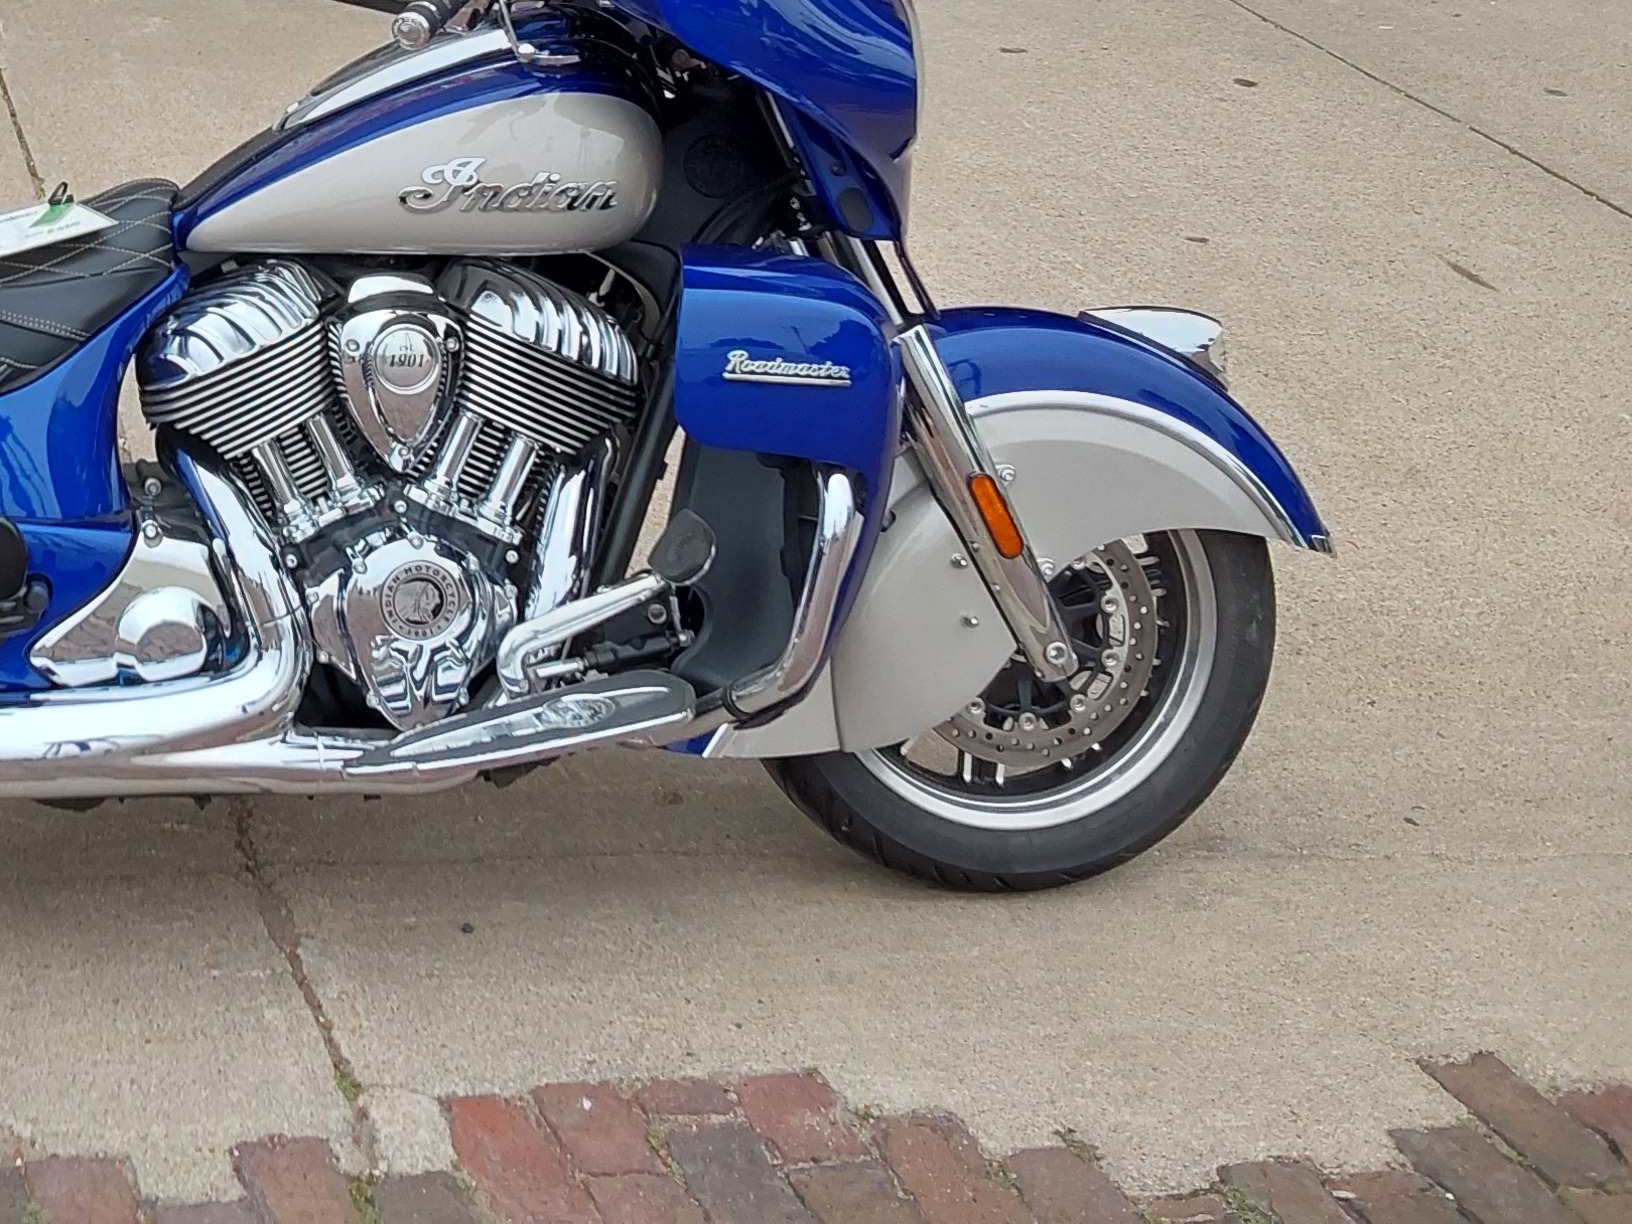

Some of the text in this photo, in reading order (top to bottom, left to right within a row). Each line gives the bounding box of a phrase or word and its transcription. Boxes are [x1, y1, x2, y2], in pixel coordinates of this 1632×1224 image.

[398, 157, 618, 214] Indian
[389, 354, 425, 368] 1901
[725, 350, 851, 379] Roadmaster
